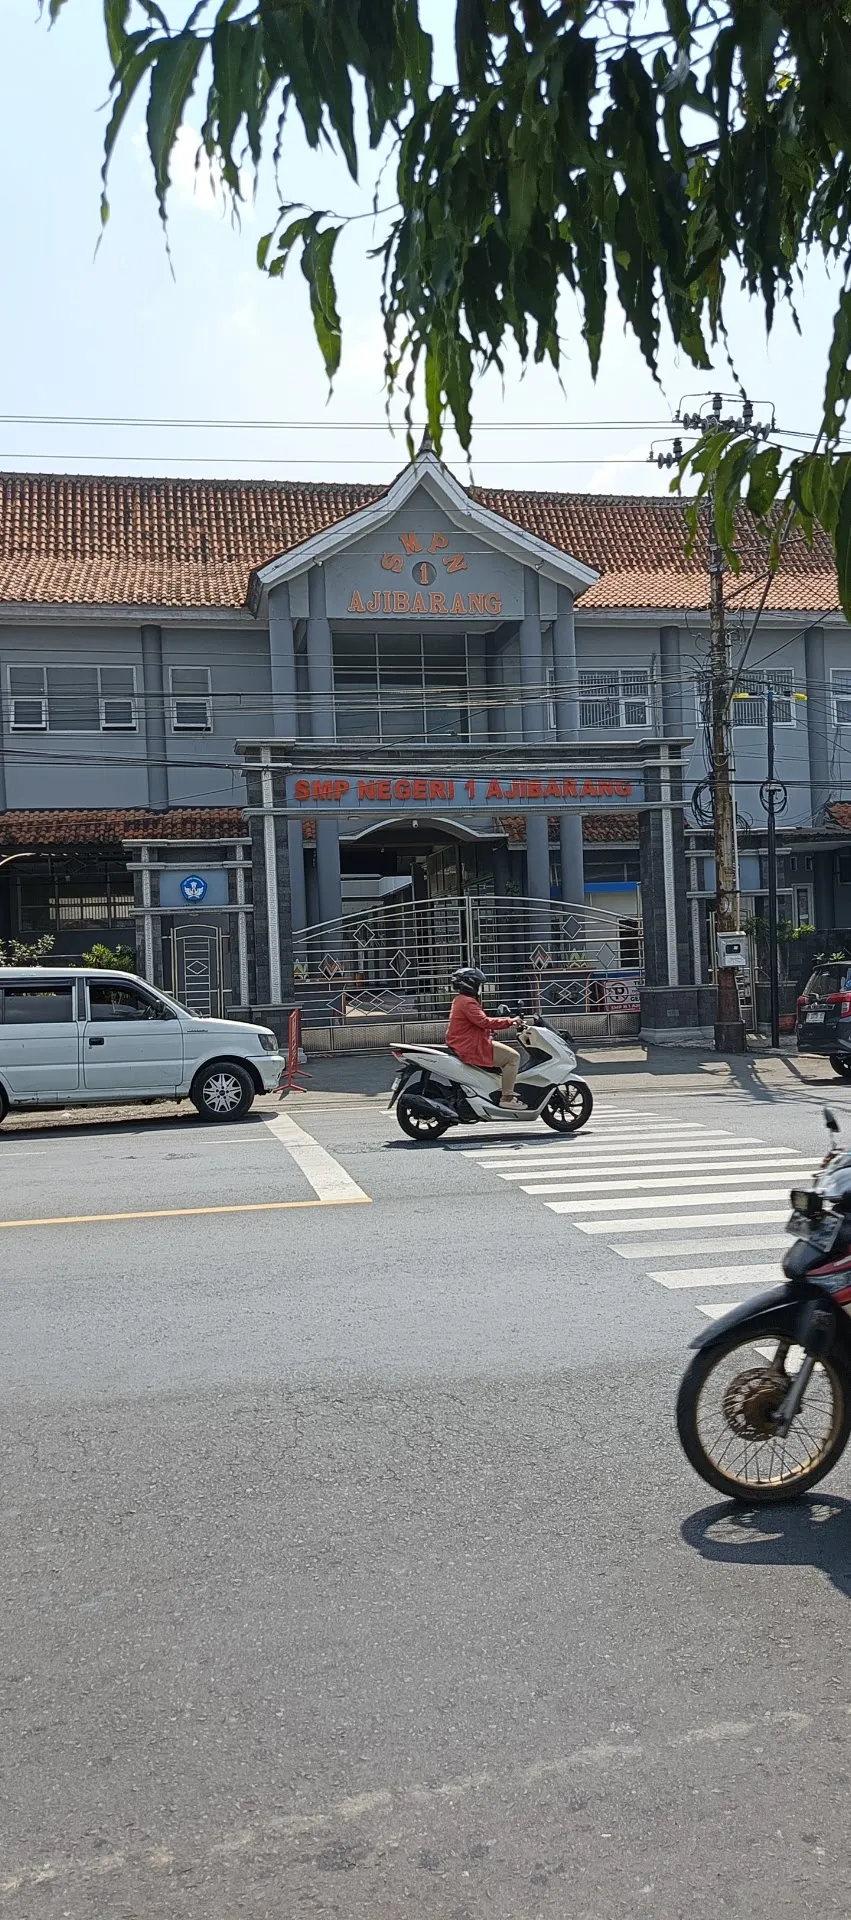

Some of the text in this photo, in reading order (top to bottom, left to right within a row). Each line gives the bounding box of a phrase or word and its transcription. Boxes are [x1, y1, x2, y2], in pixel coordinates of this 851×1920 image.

[420, 562, 429, 585] 1
[348, 590, 502, 615] AJIBARANG
[295, 777, 633, 800] SMP NEGERI 1 AJIBARANG
